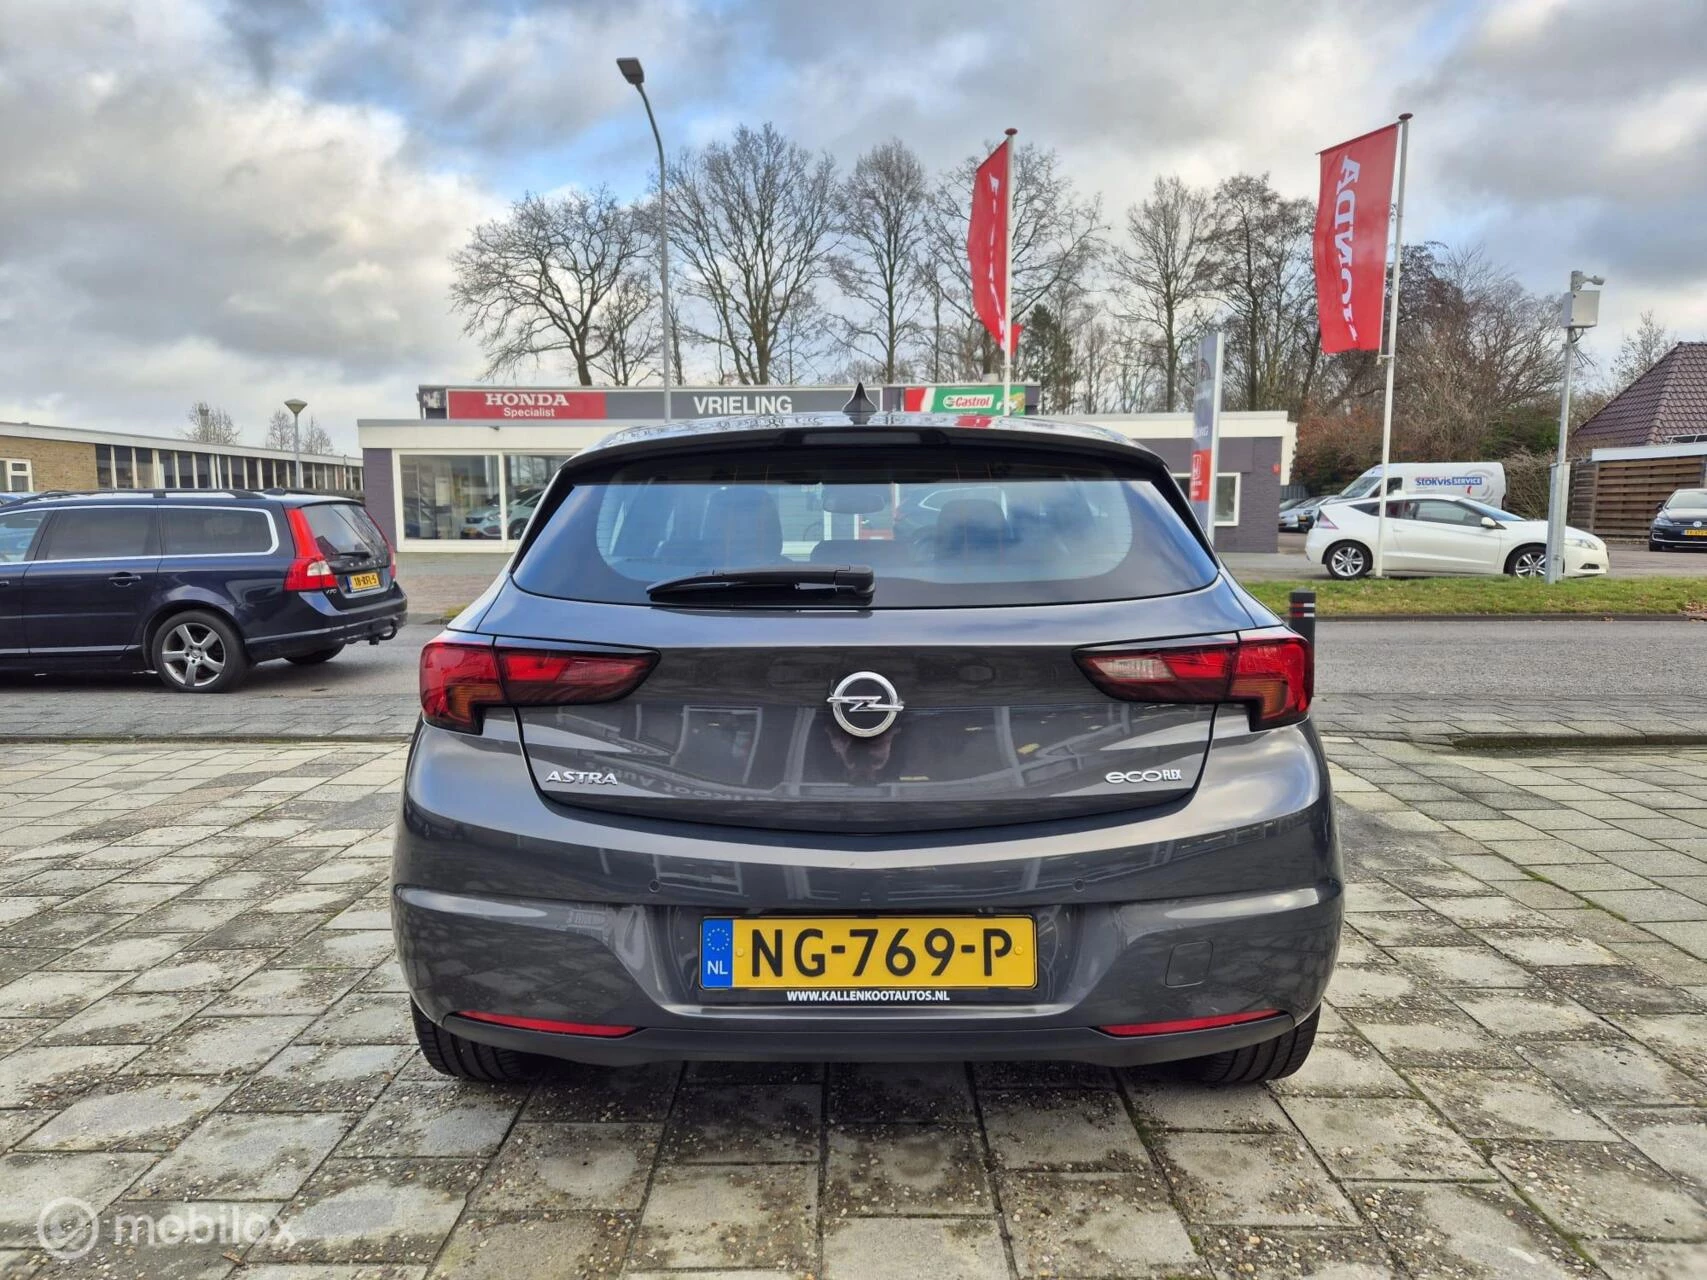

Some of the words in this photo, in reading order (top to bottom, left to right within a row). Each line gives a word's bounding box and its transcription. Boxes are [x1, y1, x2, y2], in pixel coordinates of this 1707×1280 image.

[485, 393, 569, 406] HONDA
[693, 396, 793, 415] VRIELING
[955, 396, 990, 407] Castrol
[503, 407, 555, 418] Specialist
[545, 770, 618, 786] ASTRA
[752, 928, 1012, 977] NG-769-P
[707, 961, 728, 975] NL
[786, 990, 950, 1001] WWW.KALLENKOOTAUTOS.NL
